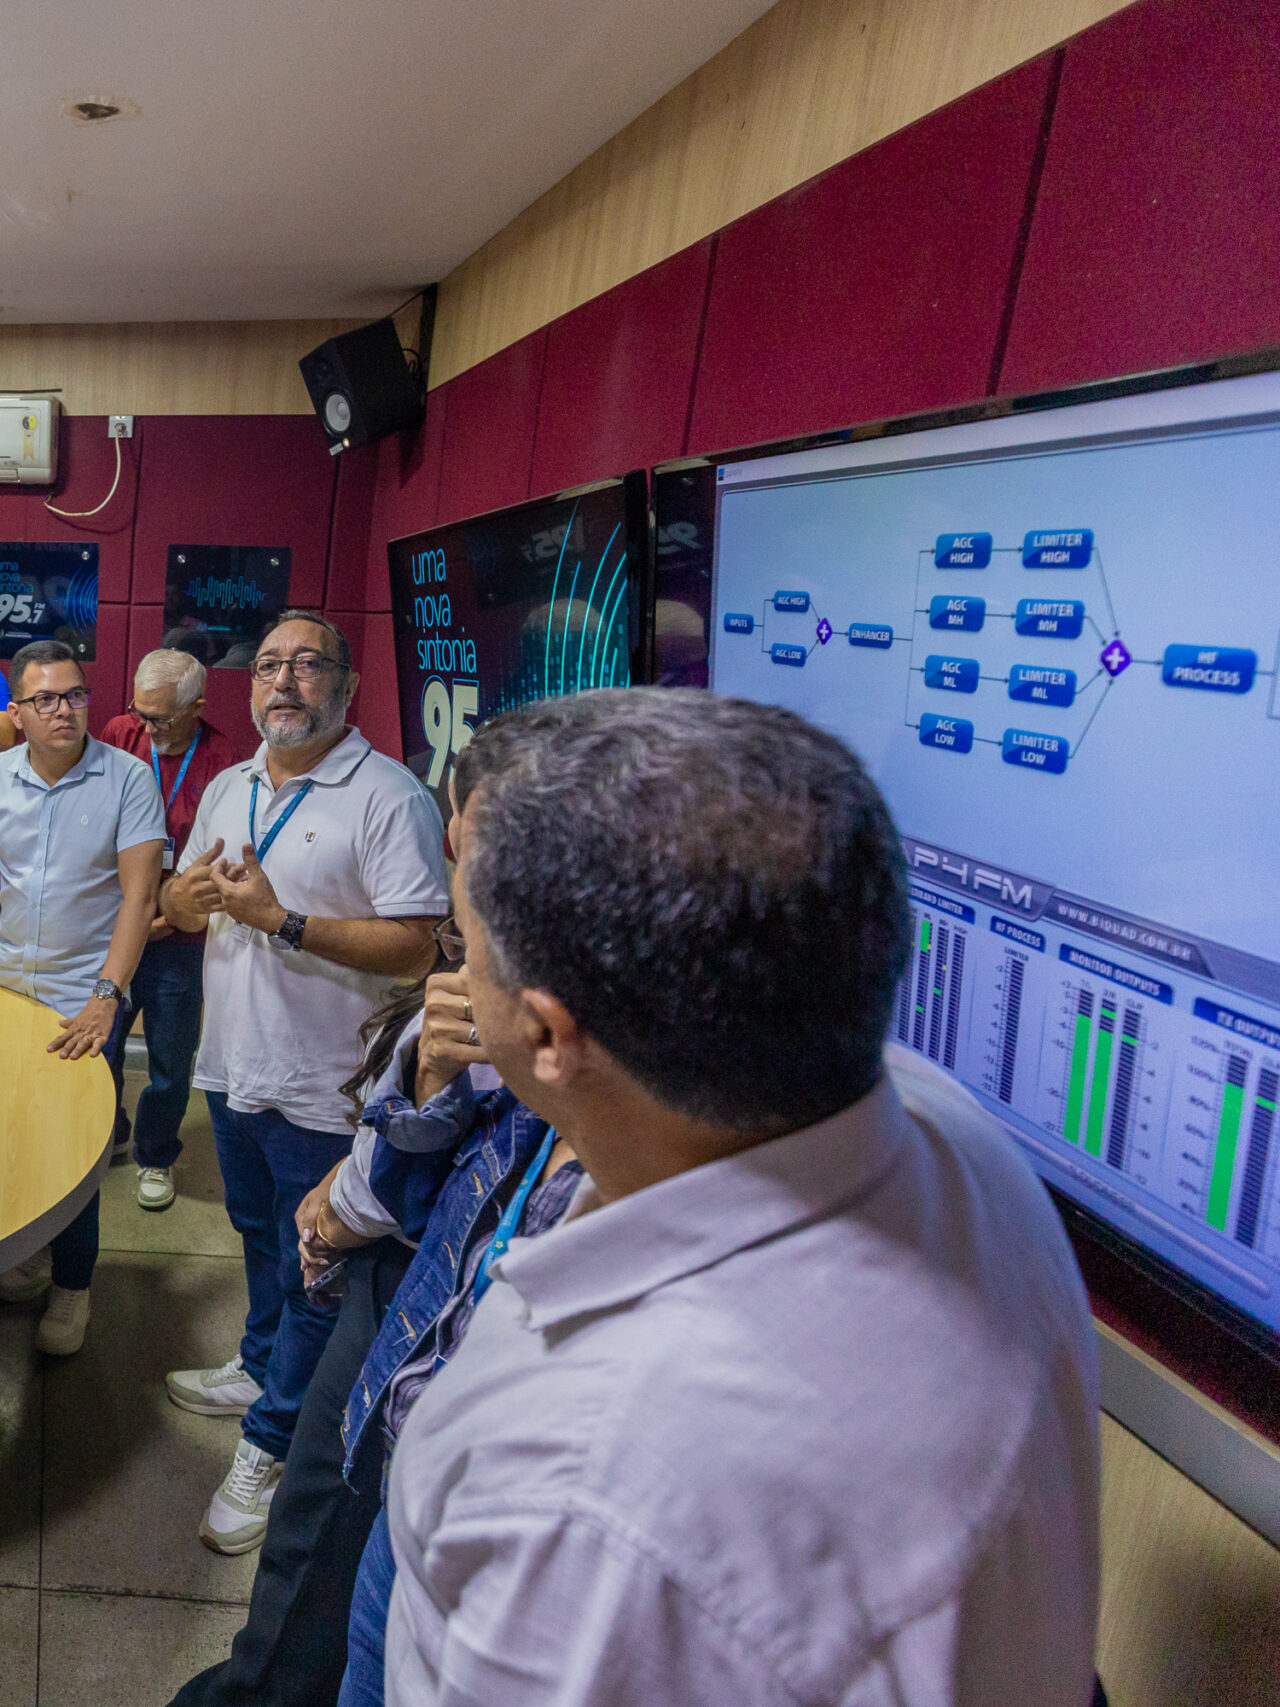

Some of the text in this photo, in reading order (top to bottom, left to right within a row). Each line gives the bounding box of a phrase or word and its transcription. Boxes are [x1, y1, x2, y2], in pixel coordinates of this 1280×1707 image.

[953, 537, 975, 548] AGC
[1033, 533, 1083, 547] LIMITER
[949, 552, 974, 563] HIGH
[1039, 551, 1071, 563] HIGH
[412, 548, 446, 585] uma
[34, 602, 46, 610] FM
[777, 596, 806, 606] AGC HIGH
[947, 600, 968, 611] AGC
[414, 593, 451, 628] nova
[1026, 603, 1074, 617] LIMITER
[948, 615, 964, 625] MH
[1037, 620, 1058, 632] MH
[851, 628, 890, 642] ENHANCER
[417, 626, 477, 673] sintonia
[775, 650, 802, 660] AGC LOW
[941, 662, 962, 674] AGC
[943, 676, 956, 688] ML
[1019, 669, 1067, 685] LIMITER
[1172, 666, 1241, 687] PROCESS
[1031, 687, 1048, 699] ML
[936, 719, 956, 732] AGC
[935, 733, 955, 746] LOW
[1012, 733, 1059, 752] LIMITER
[1021, 751, 1047, 765] LOW
[937, 897, 964, 915] LIMITER
[1007, 927, 1042, 947] PROCESS
[1069, 950, 1161, 996] MONITOR OUTPUTS
